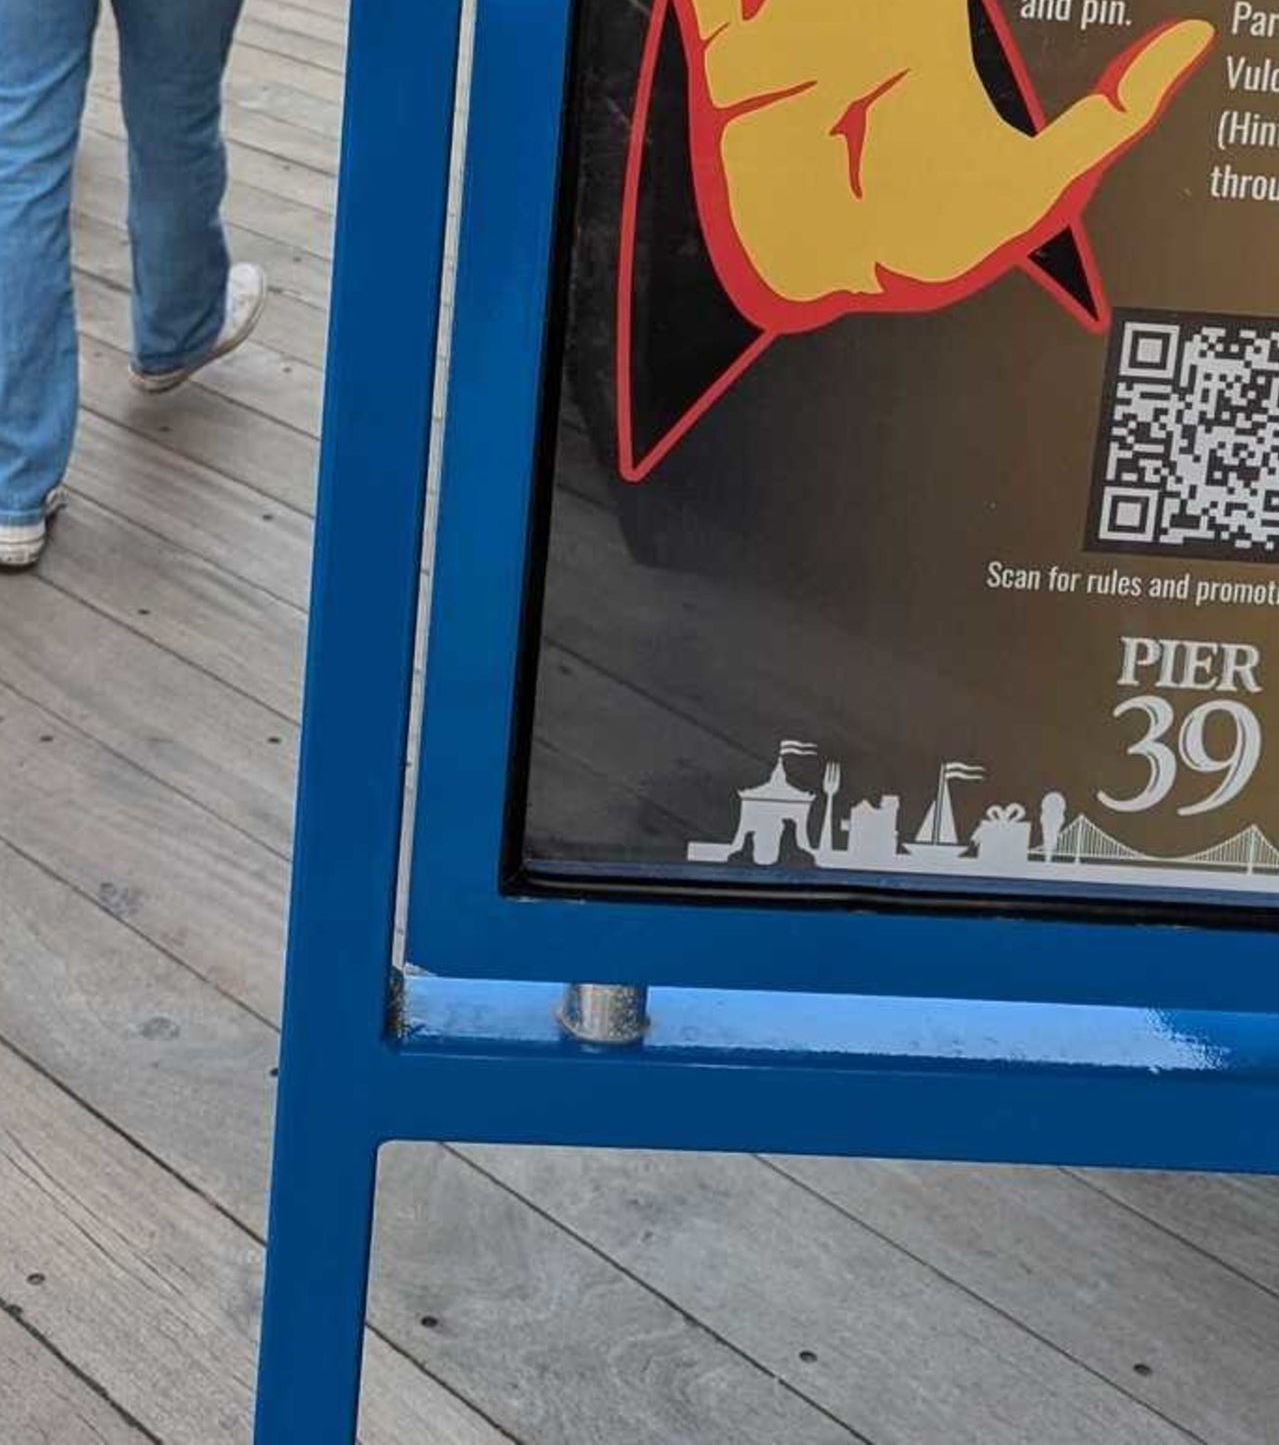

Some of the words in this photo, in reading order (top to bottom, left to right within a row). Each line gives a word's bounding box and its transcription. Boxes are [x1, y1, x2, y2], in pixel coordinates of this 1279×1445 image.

[987, 560, 1041, 591] Scan
[1048, 566, 1081, 593] for
[1087, 569, 1142, 597] rules
[1148, 573, 1189, 600] and
[1117, 636, 1263, 693] PIER
[1097, 695, 1262, 816] 39
